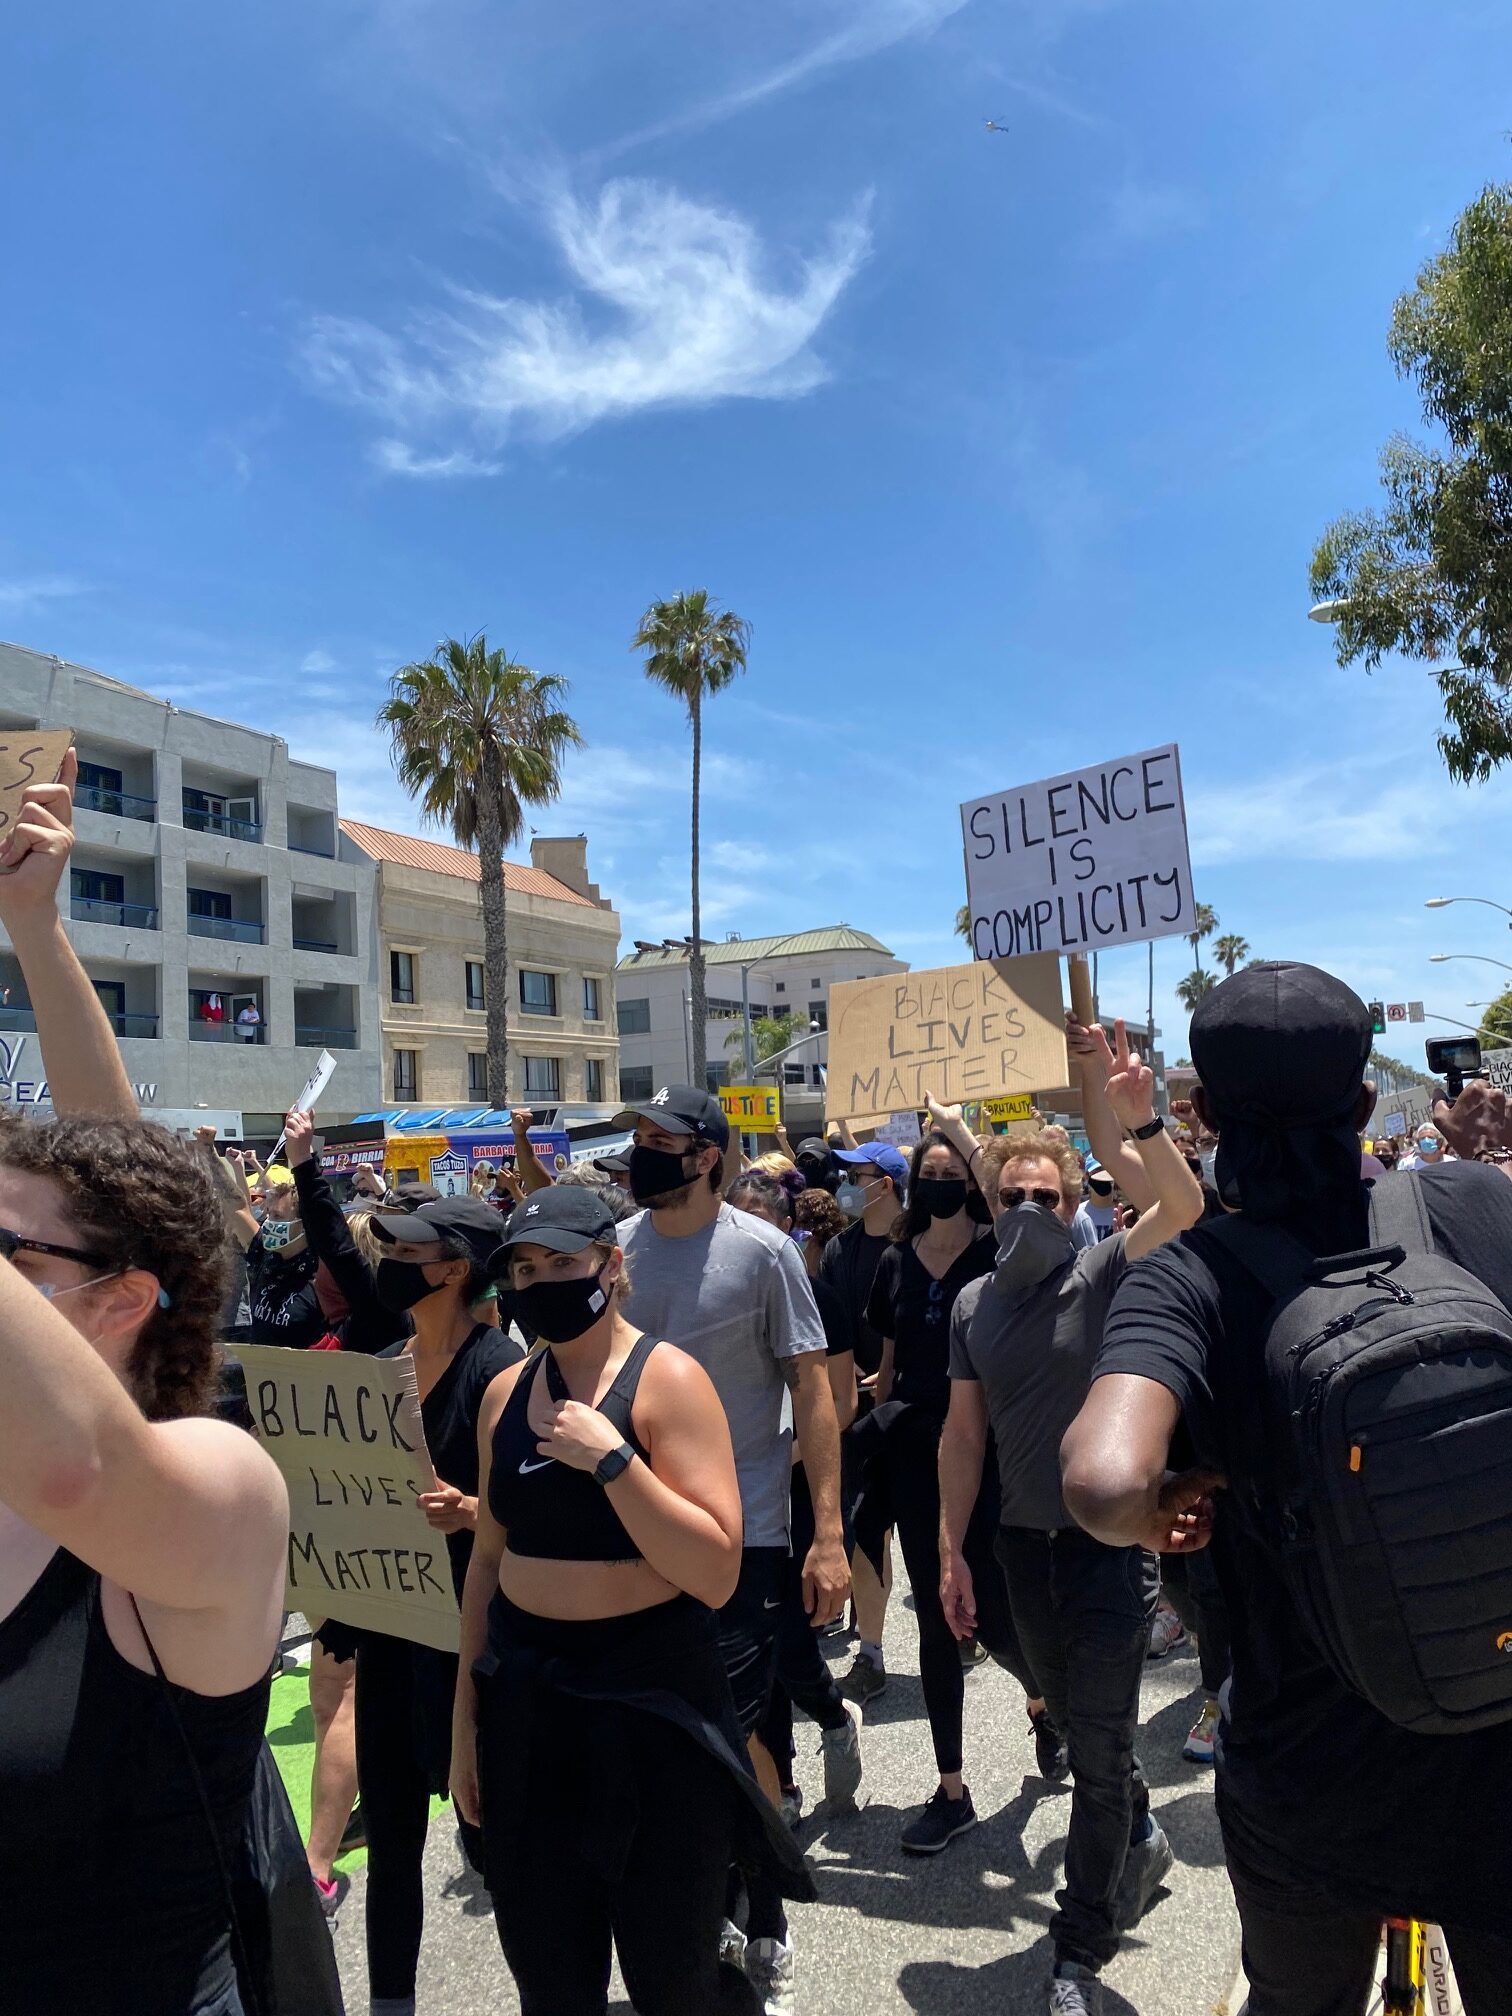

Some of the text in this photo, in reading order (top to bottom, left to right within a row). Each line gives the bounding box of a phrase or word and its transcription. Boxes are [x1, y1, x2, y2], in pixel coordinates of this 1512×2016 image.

[970, 754, 1175, 859] SILENCE
[1049, 838, 1096, 885] IS
[974, 868, 1182, 960] COMPLICITY
[888, 1008, 1025, 1059] LIVES
[850, 1049, 1034, 1112] MATTER
[988, 1100, 1031, 1116] BRUTALITY
[351, 1150, 384, 1163] BIRRIA
[433, 1161, 450, 1171] TACOS
[258, 1380, 415, 1452] BLACK
[288, 1532, 445, 1594] MATTER
